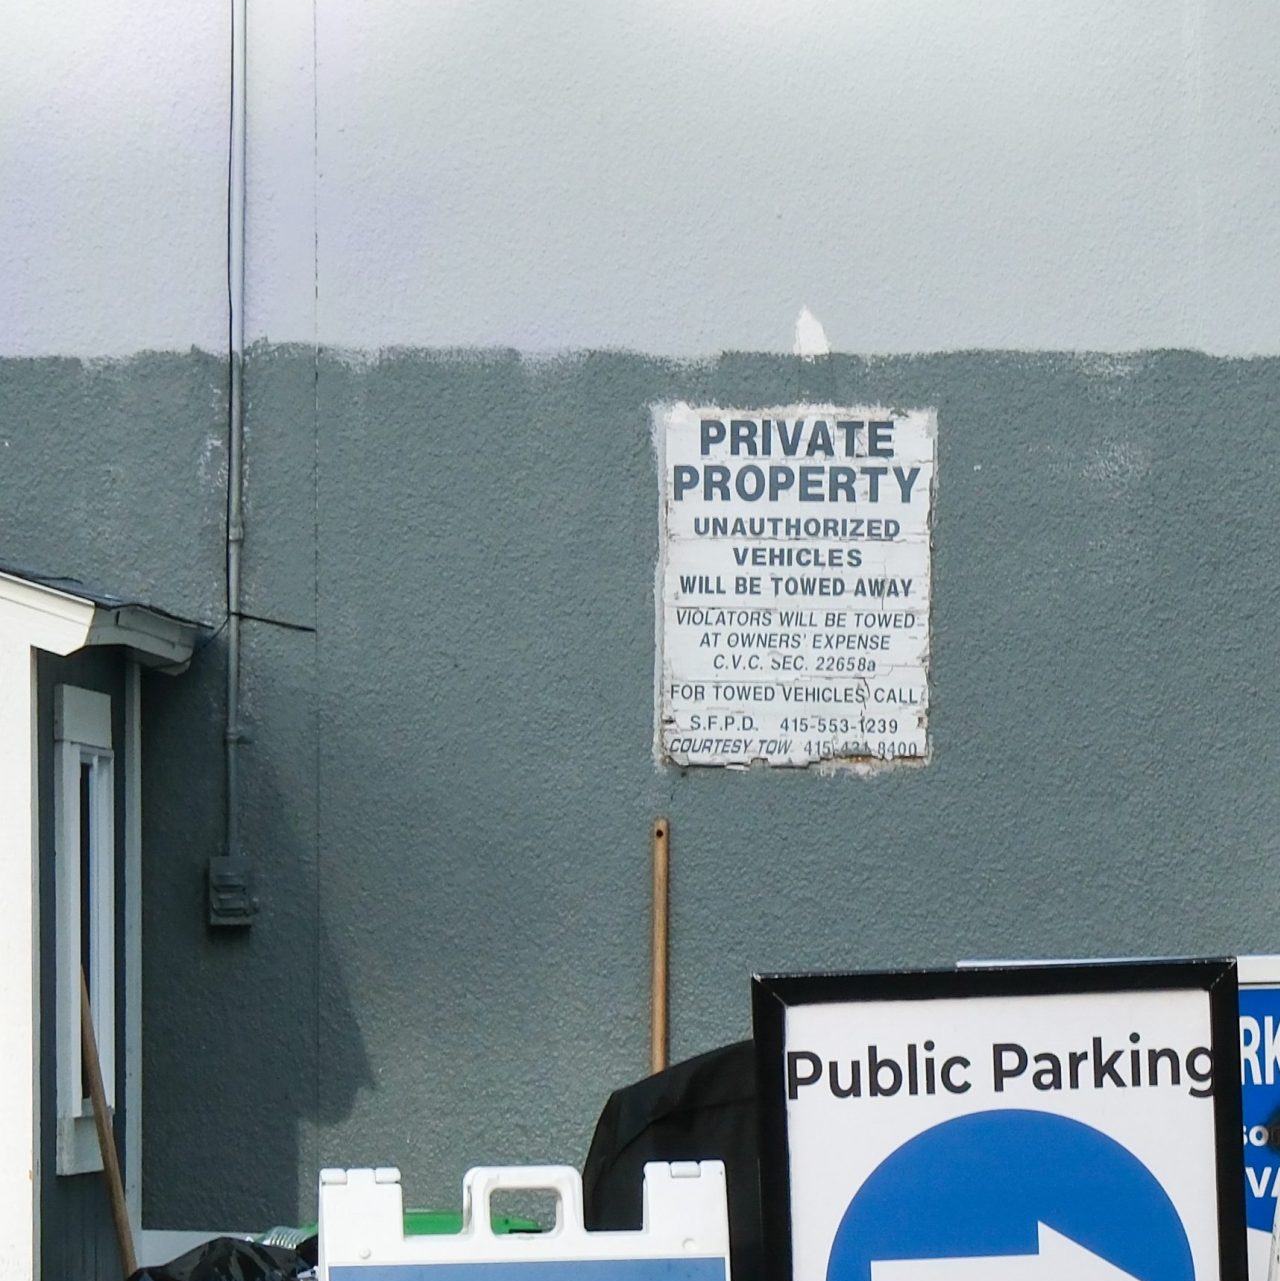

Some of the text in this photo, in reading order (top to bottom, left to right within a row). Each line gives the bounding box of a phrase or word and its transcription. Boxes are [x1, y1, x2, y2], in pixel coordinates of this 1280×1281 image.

[701, 419, 894, 459] PRIVATE
[674, 465, 920, 503] PROPERTY
[695, 518, 900, 538] UNAUTHORIZED
[733, 548, 862, 567] VEHICLES
[680, 576, 912, 597] WILL BE TOWED AWAY
[677, 610, 915, 628] VIOLATORS WILL BE TOWED
[700, 633, 890, 650] AT OWNERS' EXPENSE
[714, 654, 876, 671] C.V.C. SEC. 22658a
[671, 684, 917, 704] FOR TOWED VEHICLES CALL
[690, 715, 758, 731] S.F.P.D.
[670, 739, 753, 753] COURTESY
[759, 740, 792, 755] TOW
[787, 1032, 1215, 1100] Public Parking
